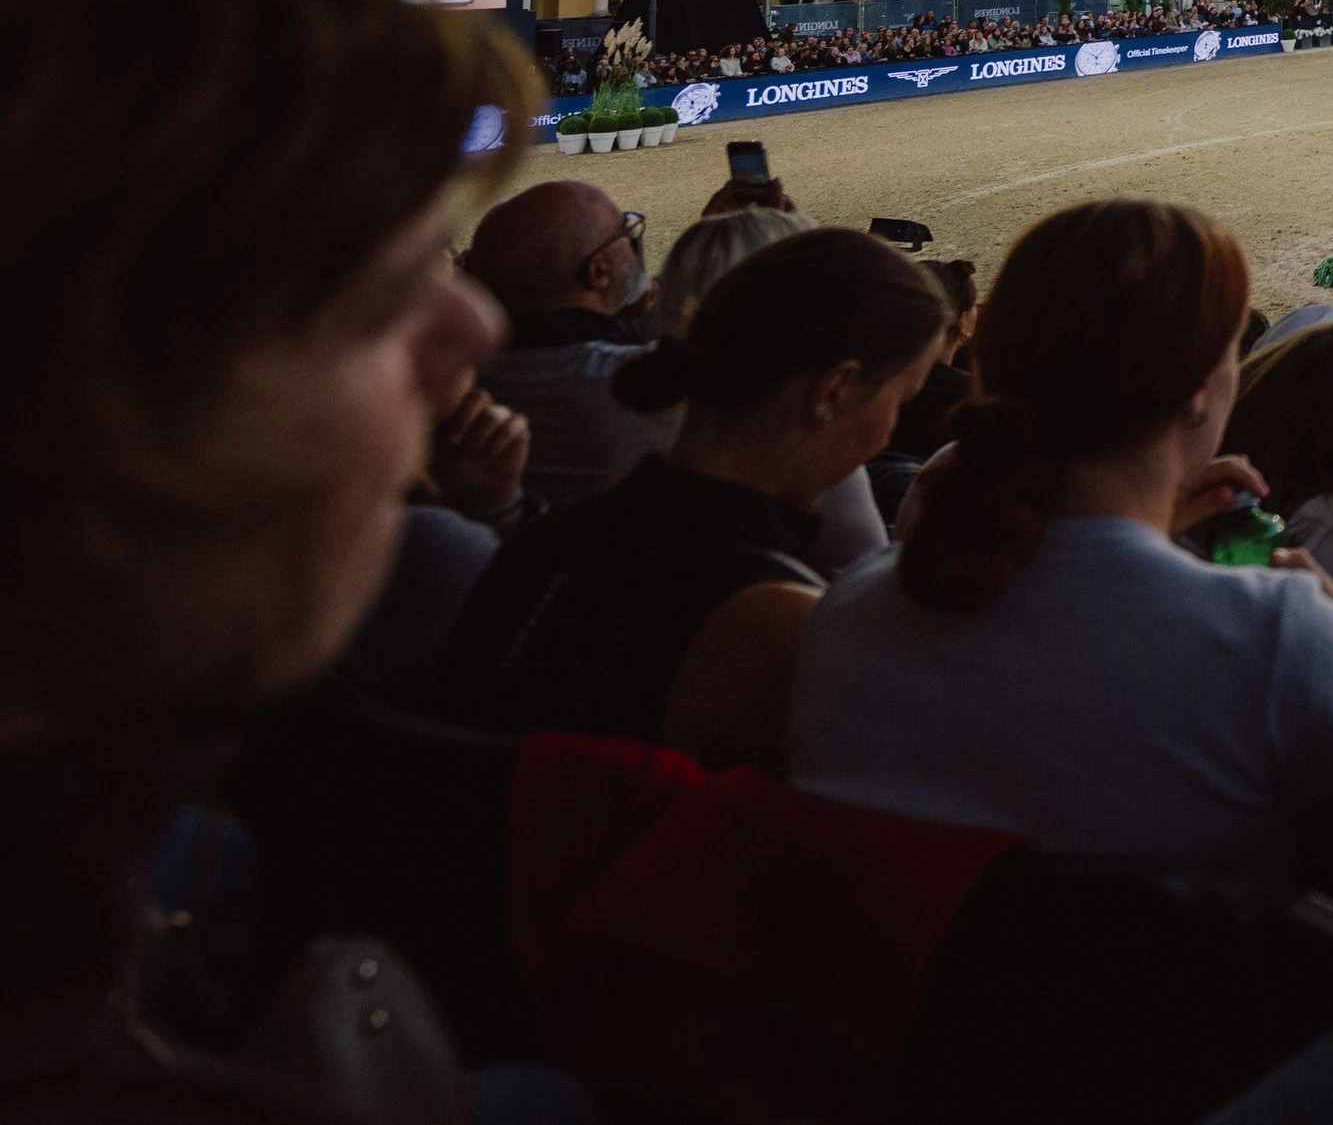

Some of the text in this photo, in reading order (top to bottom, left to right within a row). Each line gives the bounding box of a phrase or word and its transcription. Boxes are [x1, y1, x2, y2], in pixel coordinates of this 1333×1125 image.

[1127, 44, 1189, 59] Official Timekeeper
[1227, 32, 1280, 49] LONGINES
[970, 53, 1066, 81] LONGINES
[746, 75, 868, 107] LONGINES
